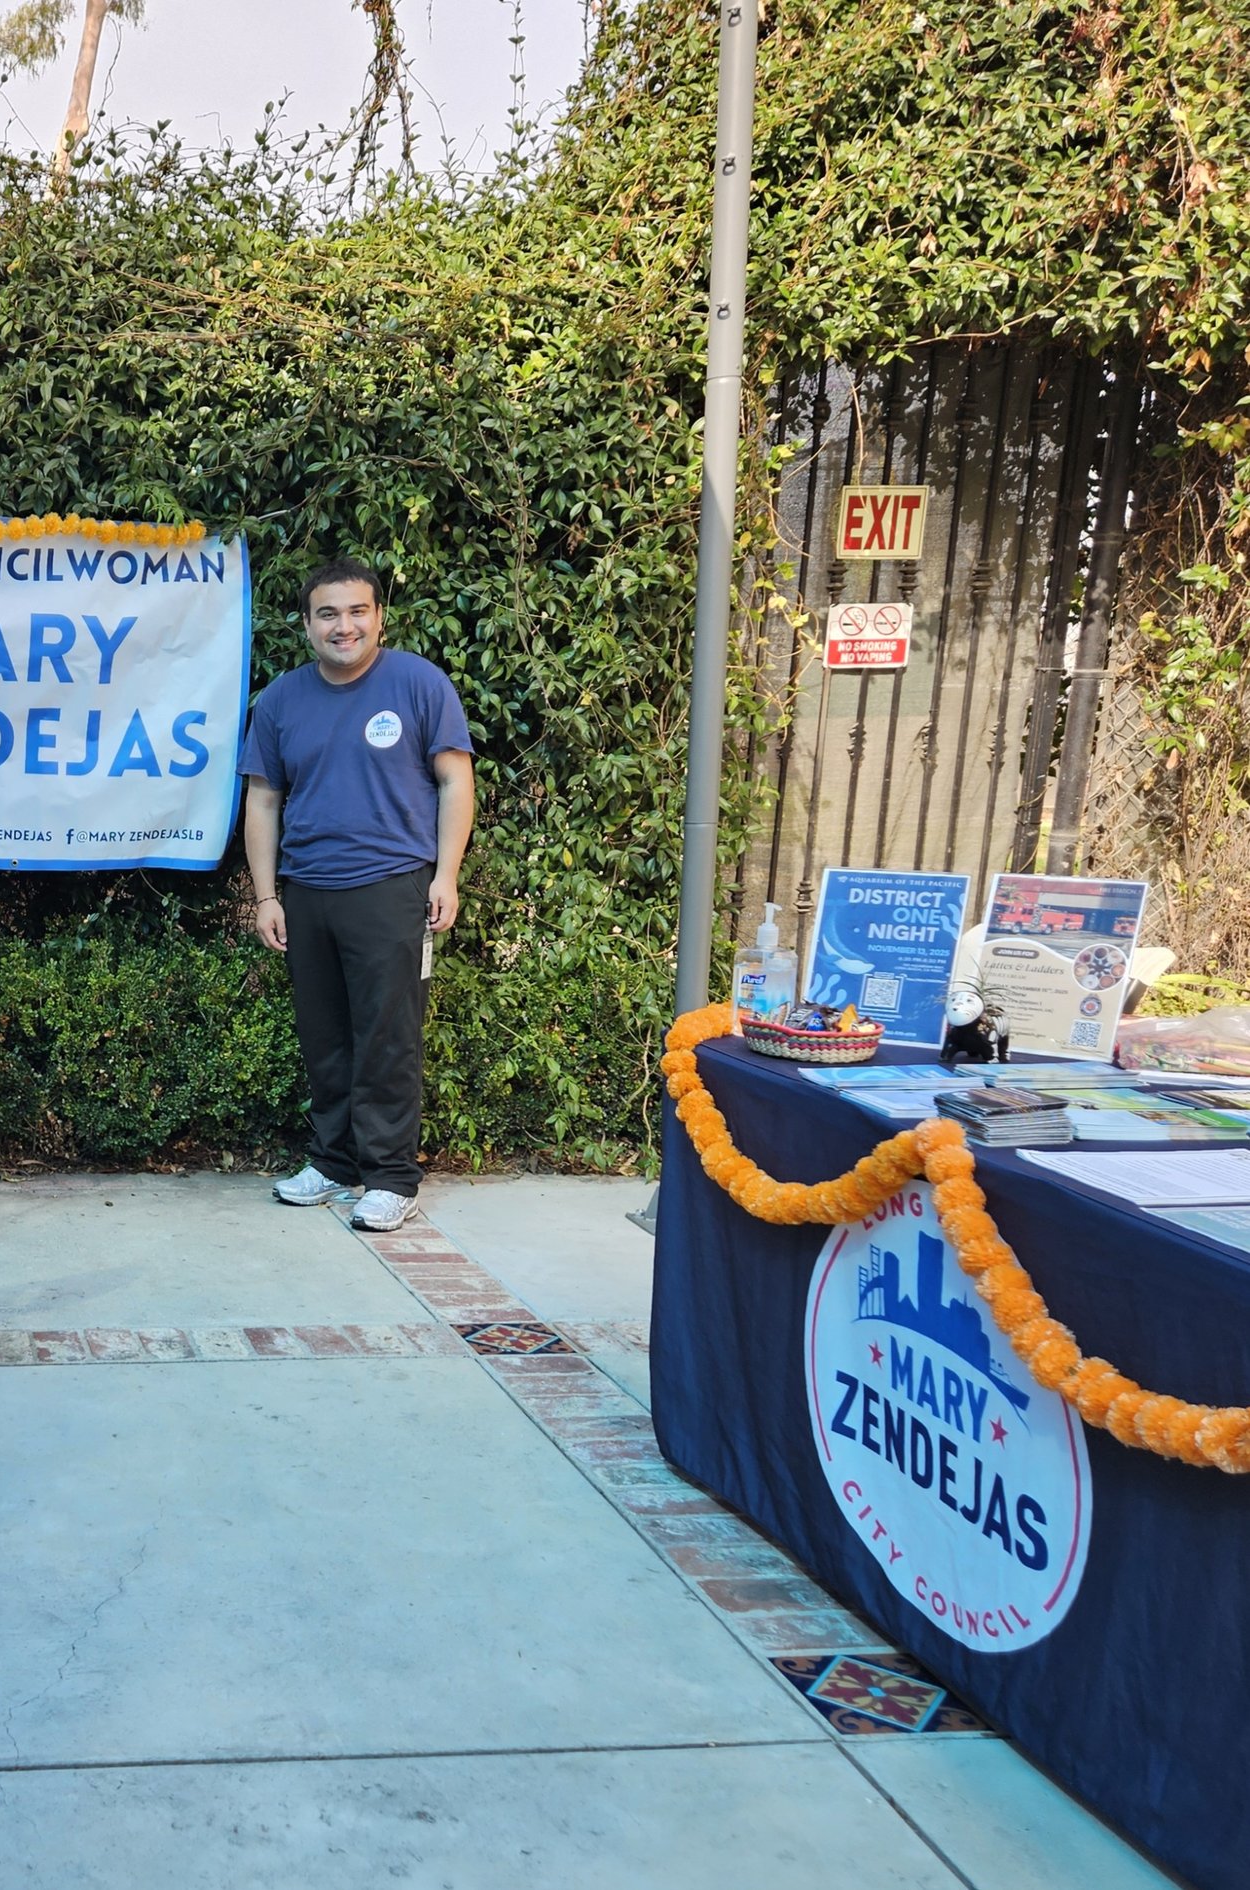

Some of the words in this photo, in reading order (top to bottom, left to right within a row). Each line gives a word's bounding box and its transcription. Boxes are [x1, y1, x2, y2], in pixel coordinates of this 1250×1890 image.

[843, 495, 921, 550] EXIT
[838, 641, 852, 651] NO
[854, 640, 897, 651] SMOKING
[840, 653, 854, 663] NO
[856, 652, 892, 662] VAPING
[76, 830, 125, 843] @MARY
[129, 829, 204, 842] ZENDEJASLB
[849, 876, 893, 885] AQUARIUM
[929, 880, 962, 888] PACIFIC
[849, 888, 945, 908] DISTRICT
[893, 907, 942, 924] ONE
[867, 923, 939, 942] NIGHT
[867, 944, 916, 954] NOVEMBER
[984, 961, 1012, 970] Lattes
[1025, 964, 1065, 975] Ladders
[890, 1335, 988, 1444] MARY
[830, 1371, 1049, 1571] ZENDEJAS
[842, 1480, 904, 1565] CITY
[915, 1575, 1031, 1639] COUNCIL
